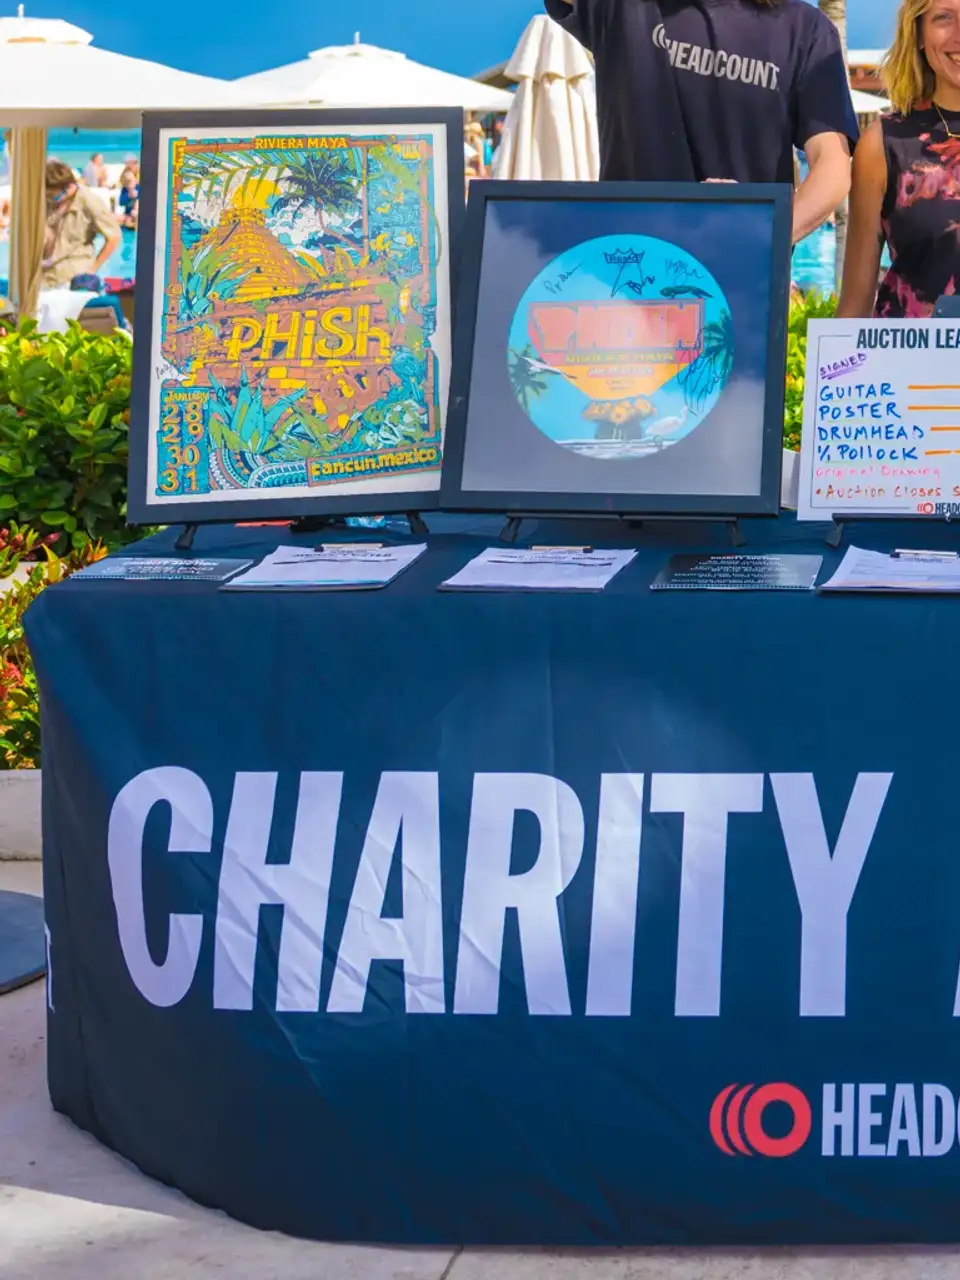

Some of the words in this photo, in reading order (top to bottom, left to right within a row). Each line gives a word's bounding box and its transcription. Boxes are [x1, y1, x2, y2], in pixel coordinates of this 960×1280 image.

[666, 37, 780, 91] HEADCOUNT
[255, 137, 304, 150] RIVIERA
[307, 136, 348, 149] MAYA
[856, 328, 929, 349] AUCTION
[820, 353, 867, 376] SIGNED
[820, 383, 895, 401] GUITAR
[819, 402, 901, 420] POSTER
[818, 424, 924, 441] DRUMHEAD
[166, 444, 200, 468] 30
[161, 468, 199, 491] 31
[826, 485, 886, 498] Auction
[107, 765, 894, 1017] CHARITY
